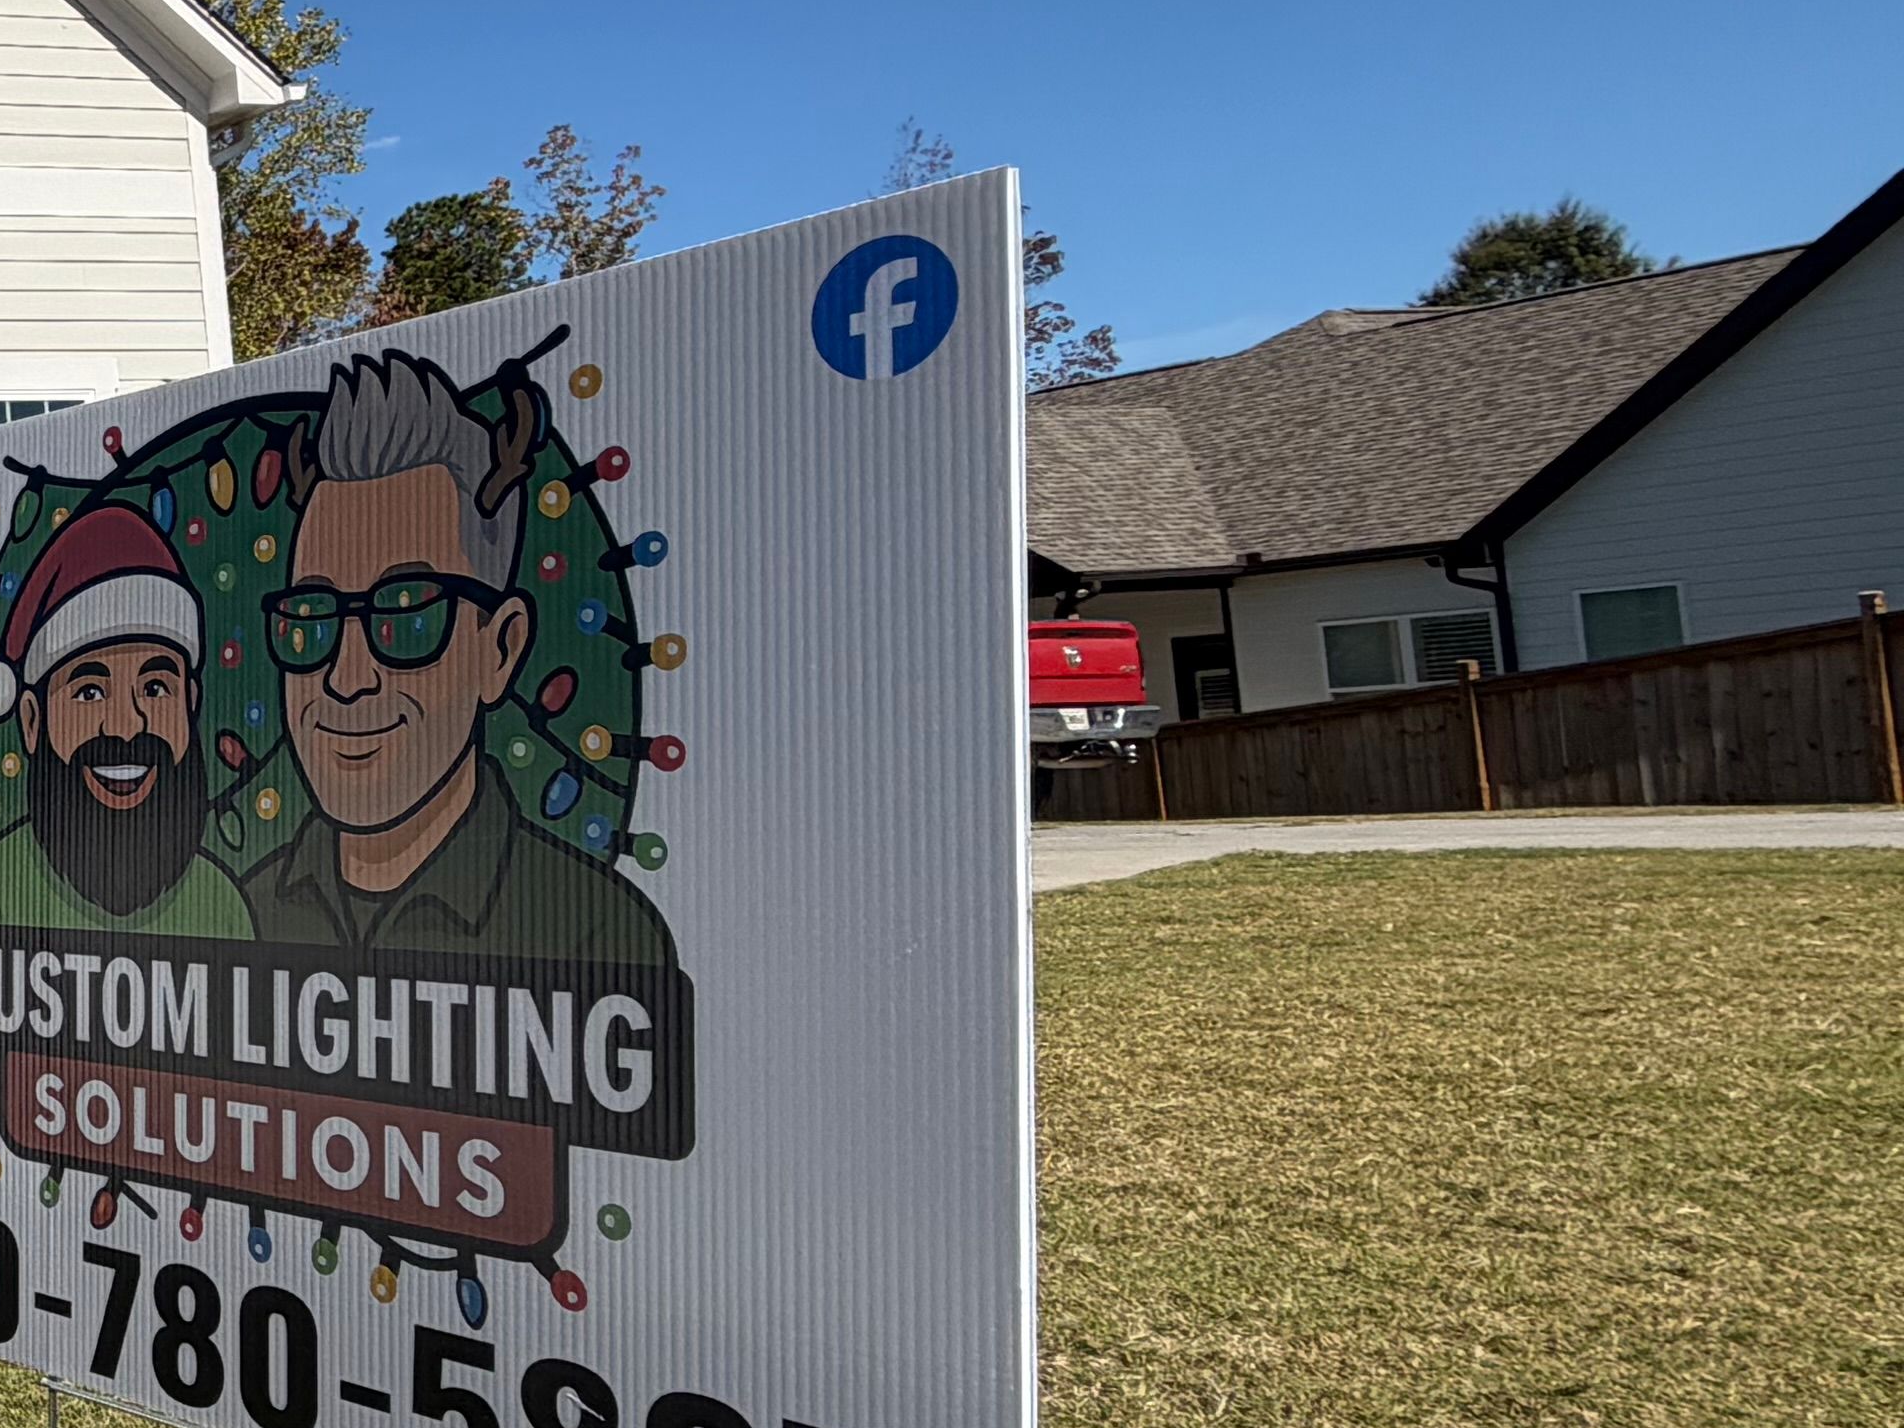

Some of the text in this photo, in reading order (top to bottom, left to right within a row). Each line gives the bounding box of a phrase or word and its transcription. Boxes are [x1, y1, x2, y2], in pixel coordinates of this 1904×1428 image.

[849, 256, 918, 380] f
[232, 967, 653, 1113] LIGHTING
[34, 1073, 505, 1218] SOLUTIONS
